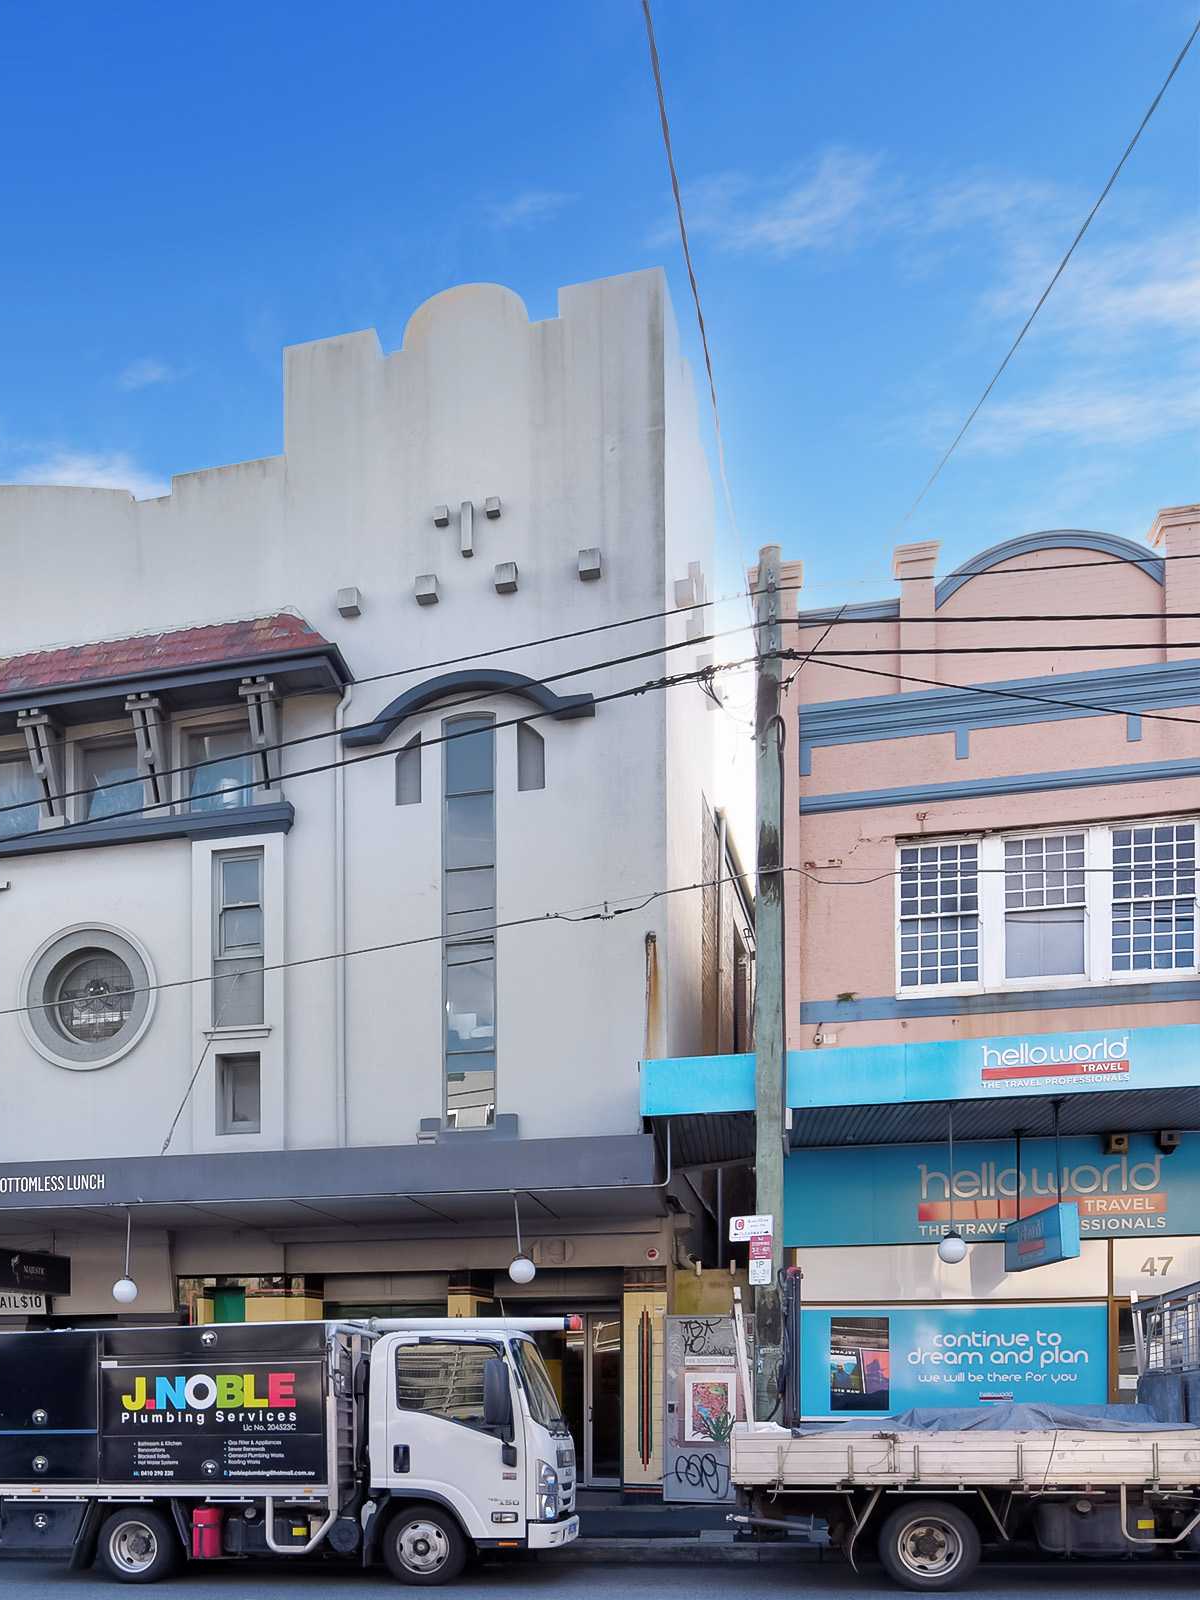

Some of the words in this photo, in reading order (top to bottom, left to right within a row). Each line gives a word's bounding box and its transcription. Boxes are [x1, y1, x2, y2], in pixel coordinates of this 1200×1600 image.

[1081, 1063, 1124, 1073] TRAVEL
[982, 1080, 1001, 1089] THE
[1005, 1079, 1041, 1088] TRAVEL
[1046, 1073, 1130, 1087] PROFESSIONALS
[67, 1174, 105, 1191] LUNCH
[1084, 1197, 1155, 1213] TRAVEL
[919, 1225, 951, 1236] THE
[955, 1223, 1007, 1236] TRAVE
[1080, 1216, 1167, 1231] SSIONALS
[1141, 1256, 1174, 1277] 47
[932, 1331, 1030, 1348] continue
[1036, 1330, 1062, 1347] to
[907, 1349, 983, 1365] dream
[990, 1347, 1033, 1365] and
[1040, 1346, 1089, 1369] plan
[918, 1373, 940, 1383] we
[943, 1371, 965, 1383] will
[968, 1371, 984, 1383] be
[987, 1371, 1021, 1383] there
[1051, 1373, 1077, 1384] you
[122, 1372, 297, 1411] J.NOBLE
[121, 1411, 205, 1425] Plumbing
[215, 1410, 297, 1422] Services
[253, 1424, 266, 1432] No.
